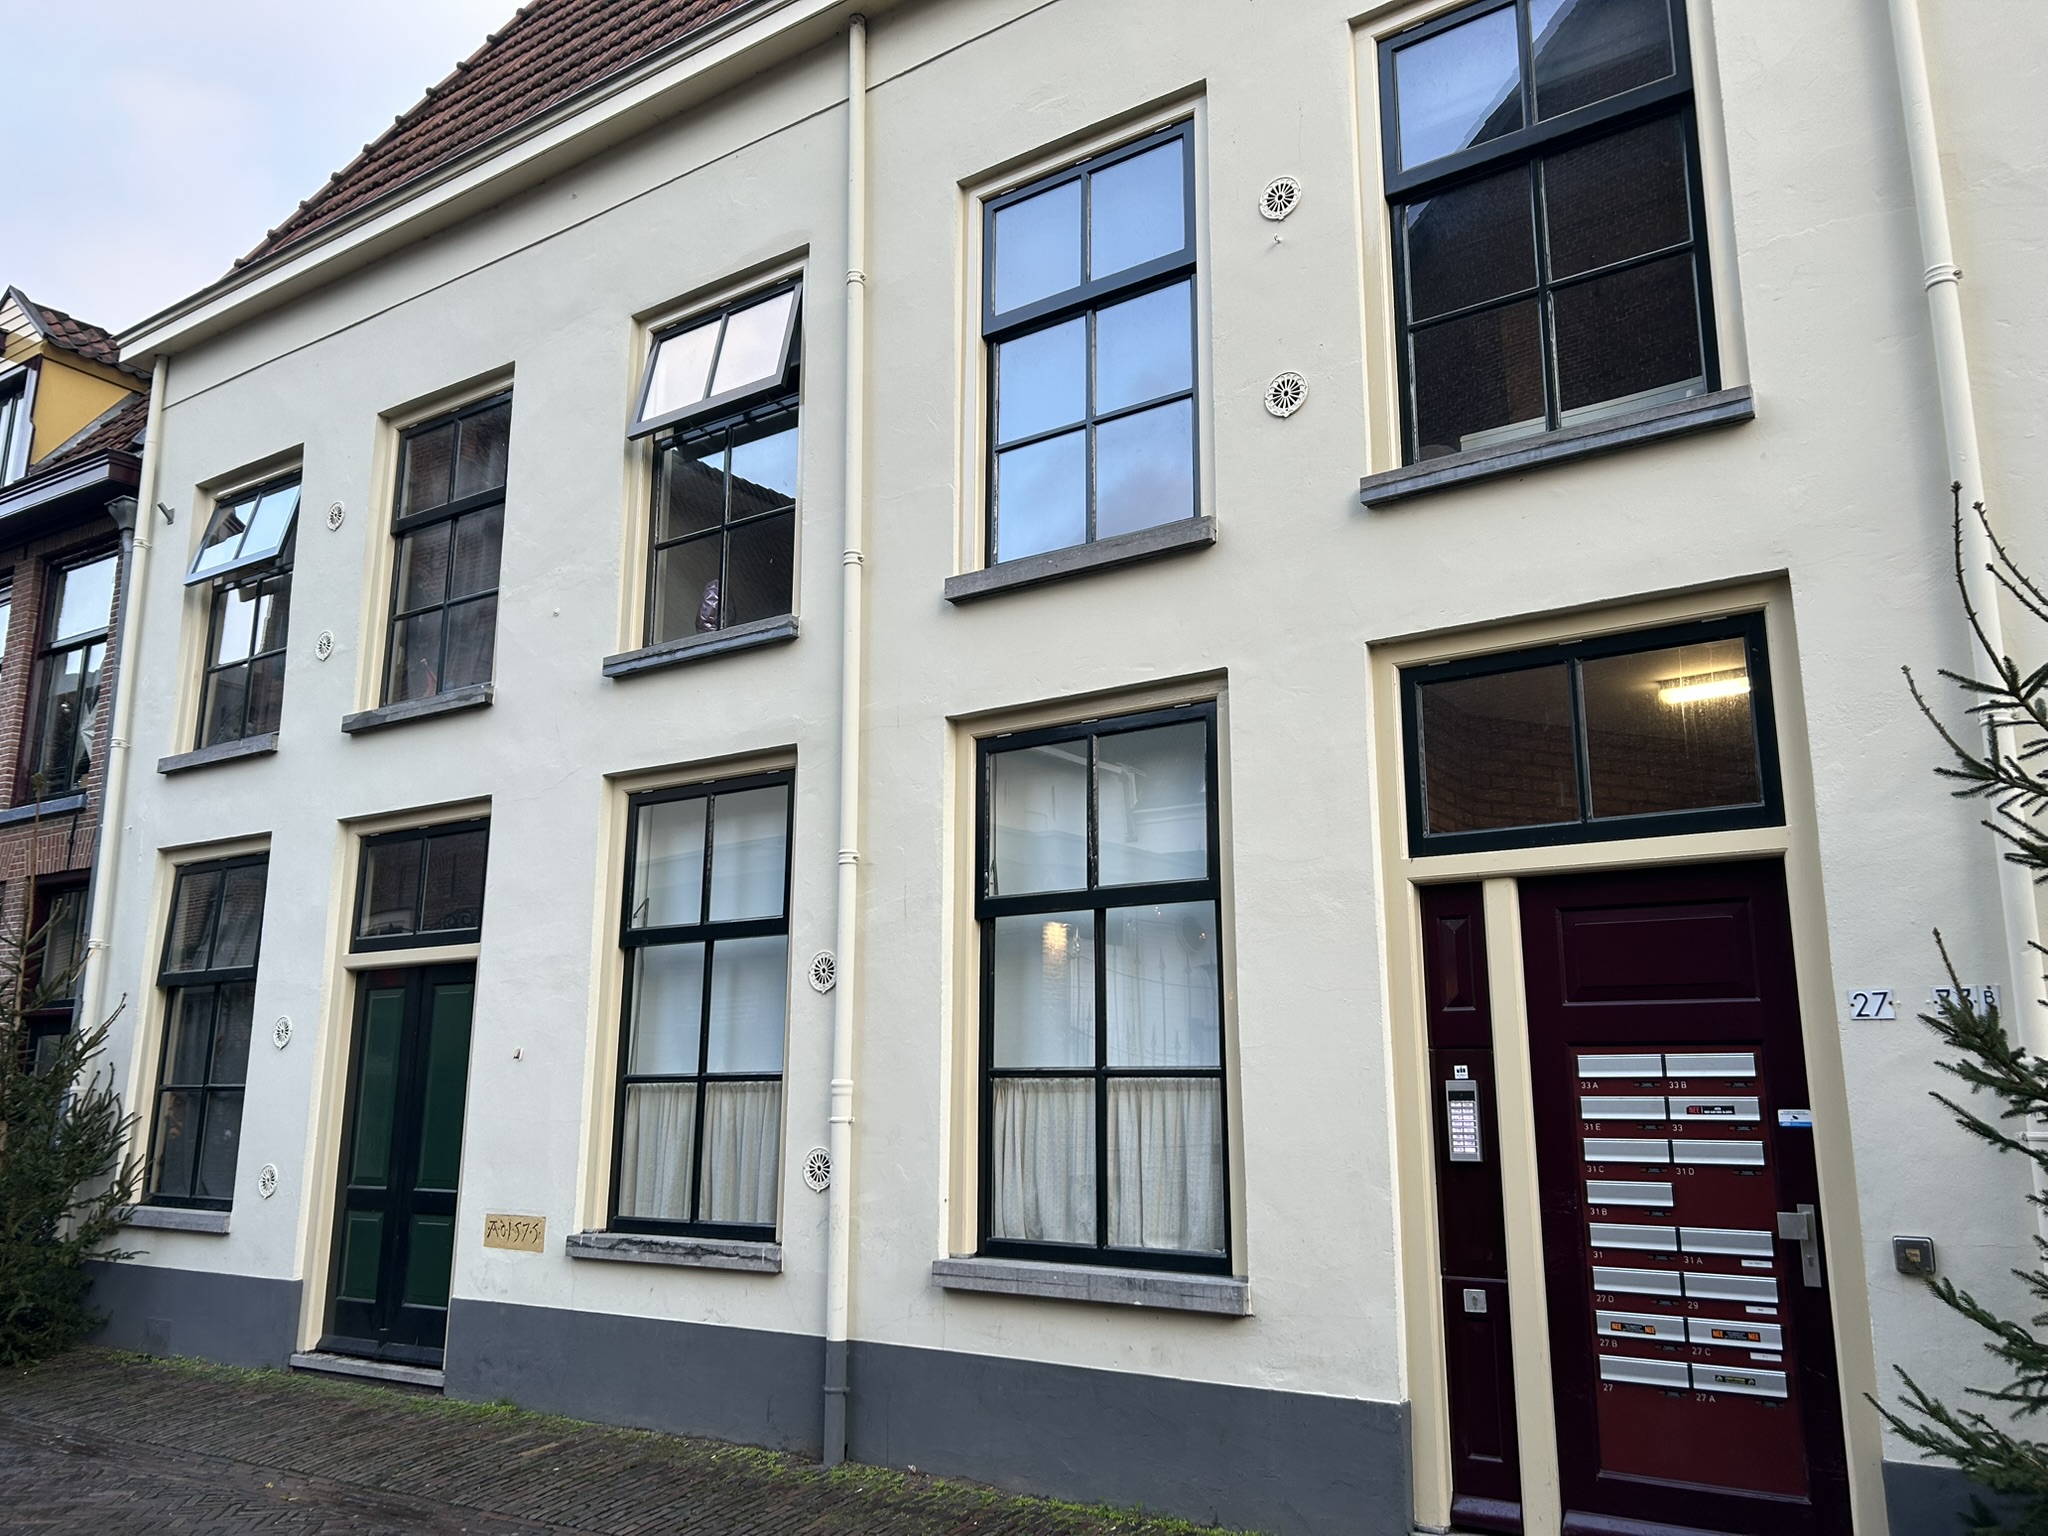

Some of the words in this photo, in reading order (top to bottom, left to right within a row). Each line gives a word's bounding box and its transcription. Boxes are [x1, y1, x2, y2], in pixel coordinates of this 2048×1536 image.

[1852, 991, 1889, 1018] 27
[1672, 1123, 1683, 1132] 33
[1592, 1250, 1603, 1259] 31
[1687, 1300, 1699, 1310] 29
[1603, 1383, 1614, 1392] 27
